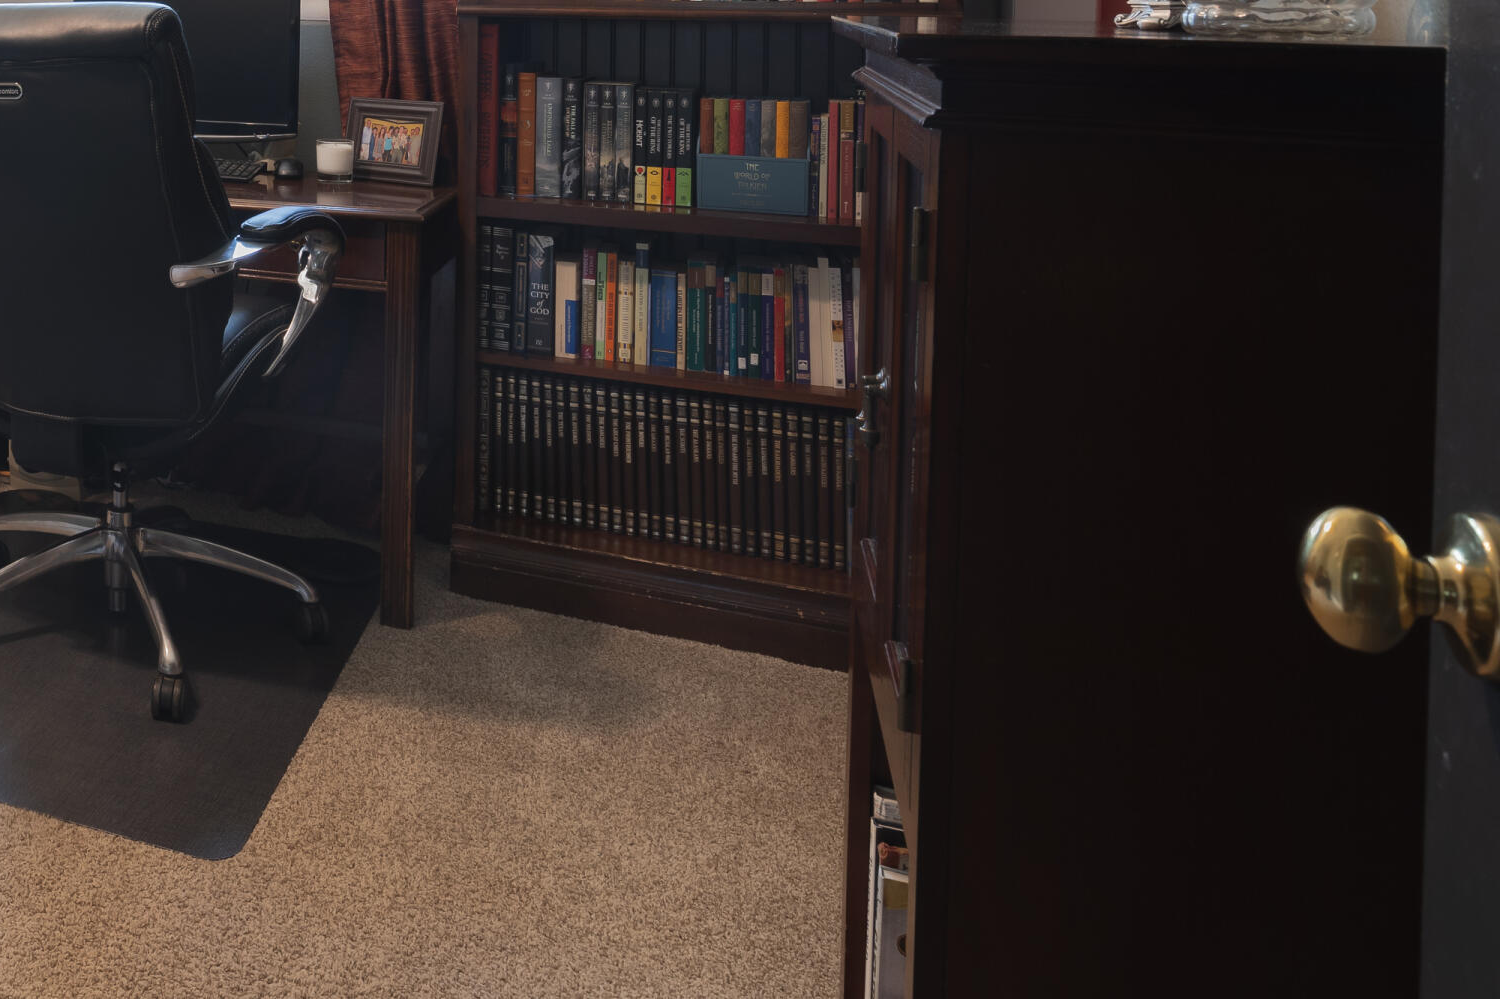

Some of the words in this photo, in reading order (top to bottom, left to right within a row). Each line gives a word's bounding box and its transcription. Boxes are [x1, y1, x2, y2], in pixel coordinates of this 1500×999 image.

[650, 116, 656, 124] OF
[679, 118, 685, 126] OF
[570, 131, 576, 139] OF
[636, 120, 644, 148] HOBBIT
[745, 162, 760, 170] THE
[738, 180, 769, 192] TOLKIEN
[531, 282, 549, 291] THE
[530, 290, 550, 299] CITY
[536, 298, 544, 307] of
[529, 307, 550, 315] GOD
